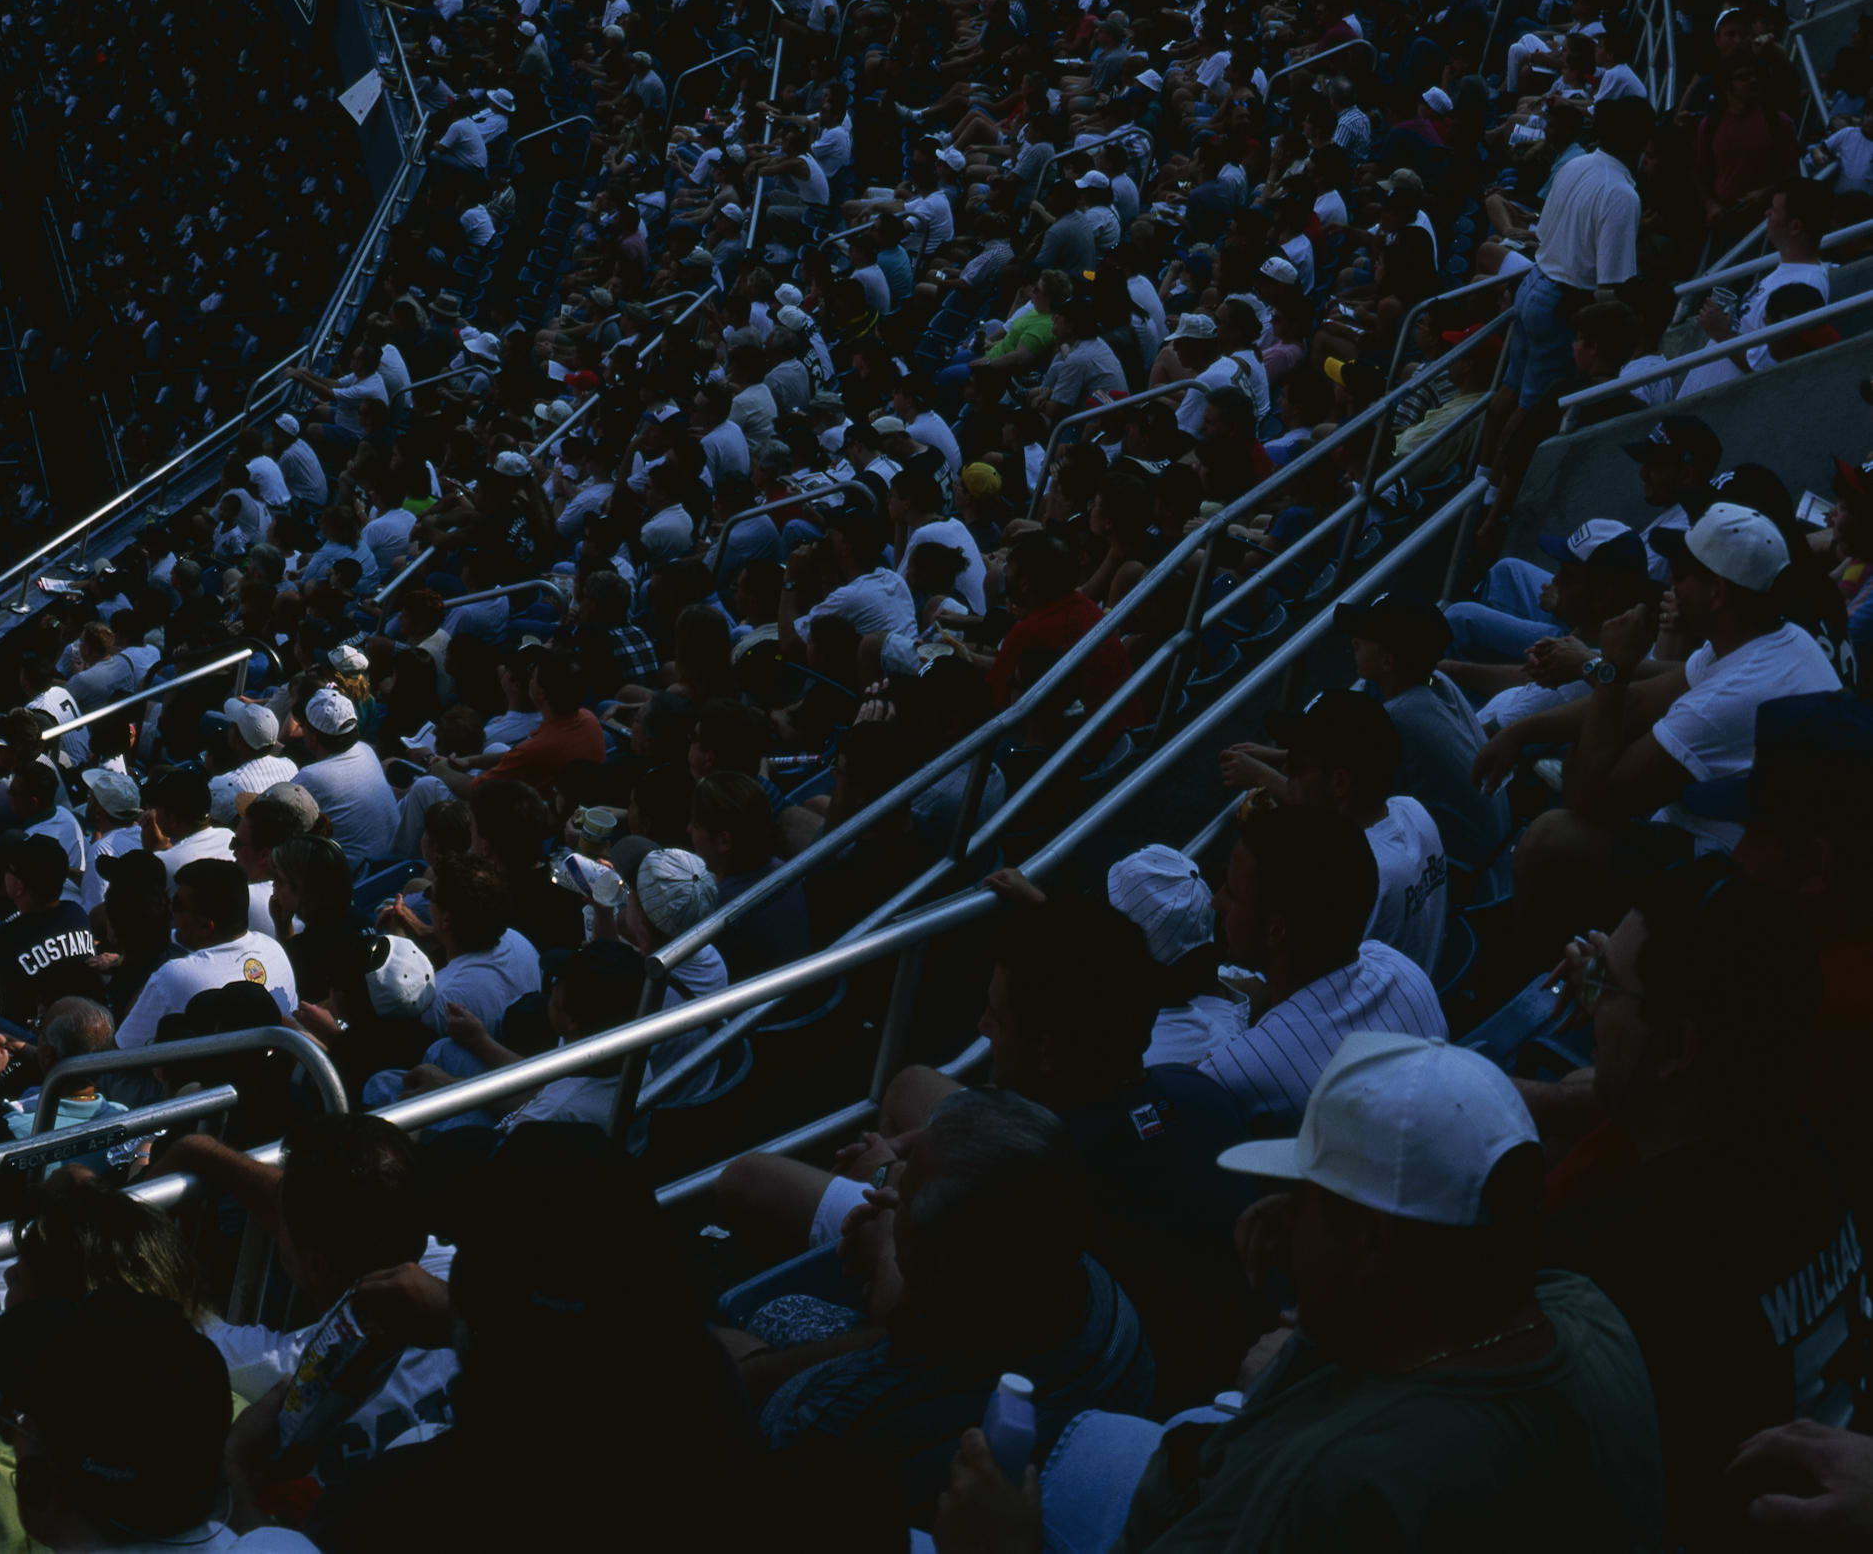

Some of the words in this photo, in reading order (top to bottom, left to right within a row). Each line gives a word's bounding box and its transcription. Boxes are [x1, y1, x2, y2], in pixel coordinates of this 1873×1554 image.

[18, 1151, 48, 1169] BOX
[53, 1146, 79, 1161] 601
[88, 1134, 119, 1151] A-F
